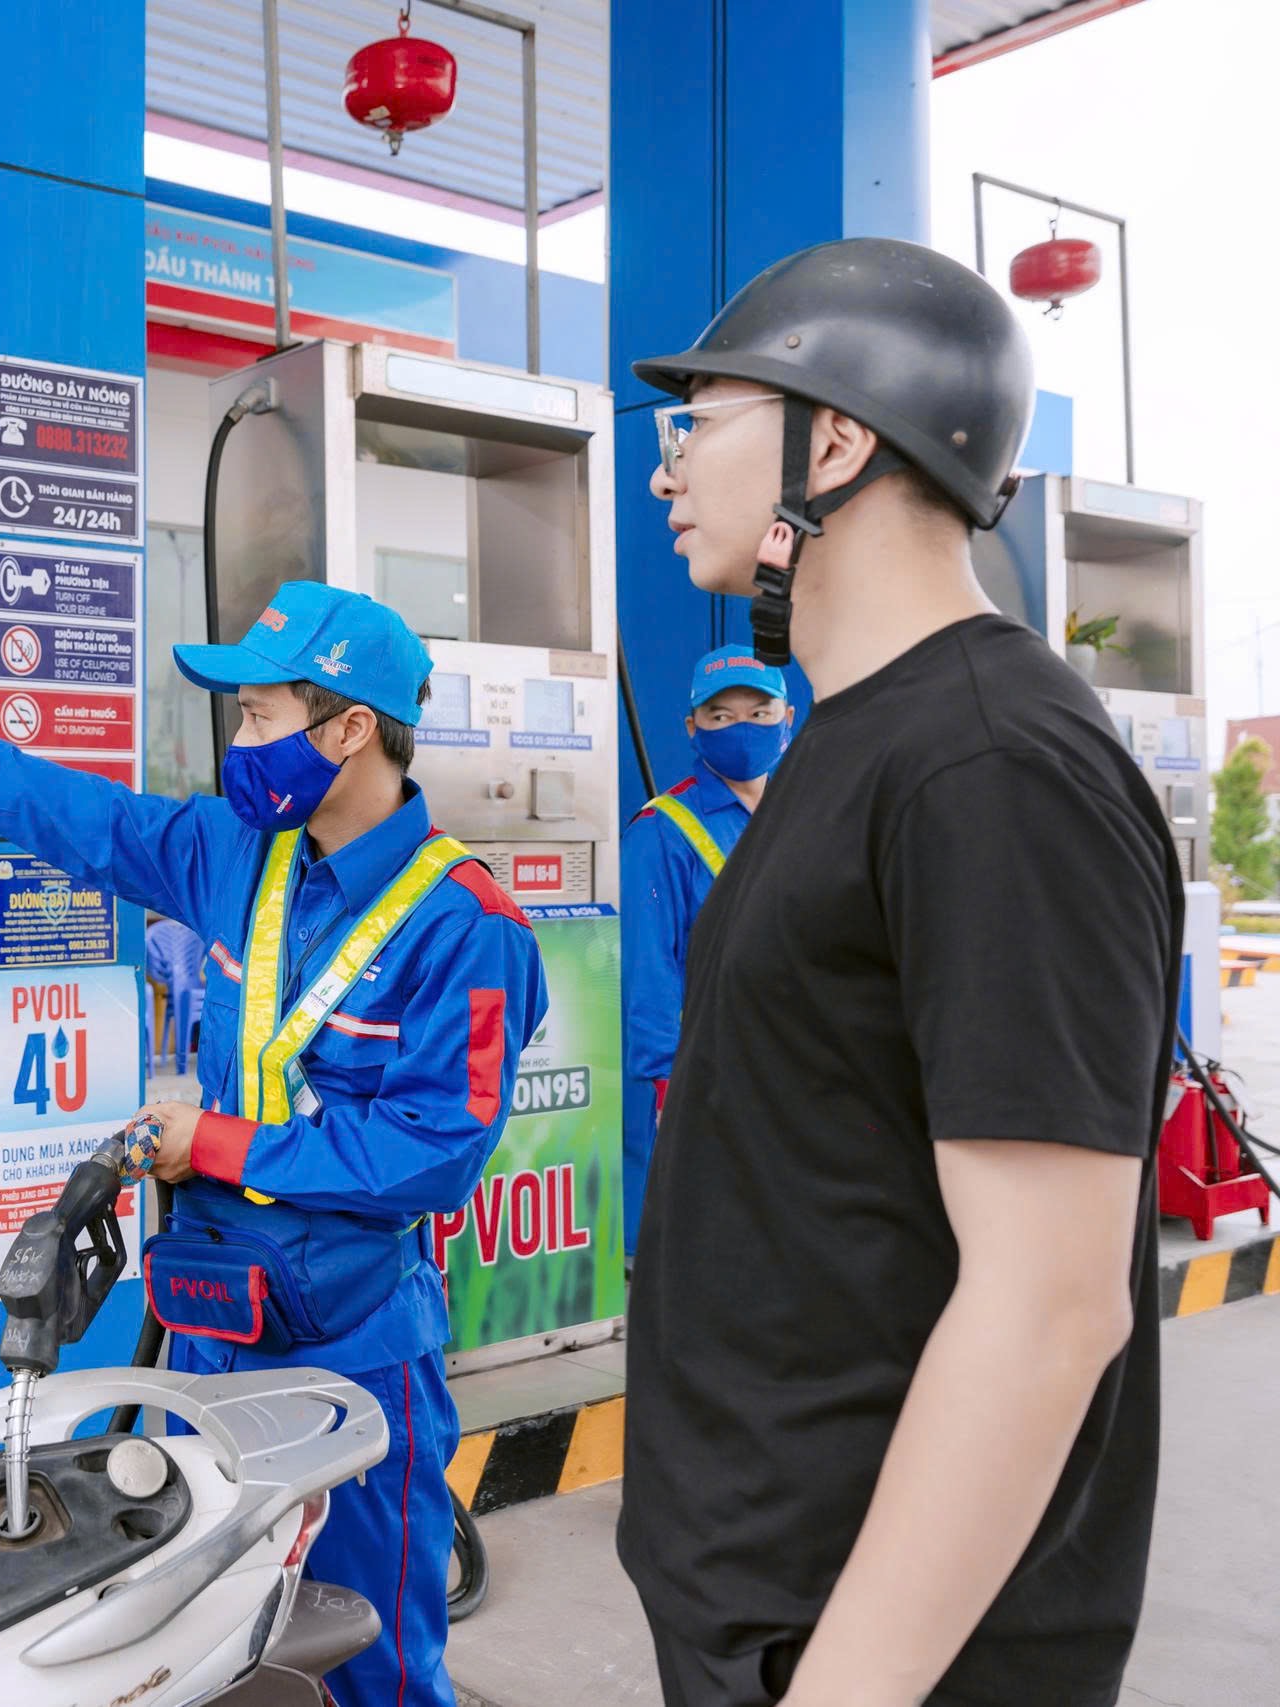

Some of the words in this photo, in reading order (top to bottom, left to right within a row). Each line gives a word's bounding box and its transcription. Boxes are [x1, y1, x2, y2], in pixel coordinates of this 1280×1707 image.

[190, 259, 261, 294] THÀNH
[0, 373, 54, 394] ĐƯỜNG
[56, 381, 85, 399] DÂY
[89, 386, 131, 405] NÓNG
[38, 484, 60, 496] THỜI
[62, 487, 84, 499] GIAN
[86, 489, 105, 501] BÁN
[107, 491, 133, 504] HÀNG
[53, 506, 121, 531] 24/24h
[71, 565, 90, 577] MÁY
[54, 591, 75, 602] TURN
[76, 594, 91, 603] OFF
[55, 604, 77, 614] YOUR
[78, 606, 107, 616] ENGINE
[55, 659, 68, 668] USE
[70, 659, 81, 669] OF
[82, 660, 131, 672] CELLPHONES
[62, 671, 79, 680] NOT
[80, 672, 118, 682] ALLOWED
[55, 725, 67, 735] NO
[69, 726, 105, 736] SMOKING
[72, 888, 102, 907] NÓNG
[12, 983, 87, 1024] PVOIL
[14, 1029, 87, 1115] 4U
[512, 1071, 586, 1111] ON95
[2, 1148, 35, 1166] DỤNG
[39, 1143, 64, 1159] MUA
[68, 1139, 98, 1156] XĂNG
[3, 1167, 22, 1181] CHO
[26, 1163, 55, 1178] KHÁCH
[432, 1163, 591, 1273] PVOIL
[171, 1277, 232, 1303] PVOIL
